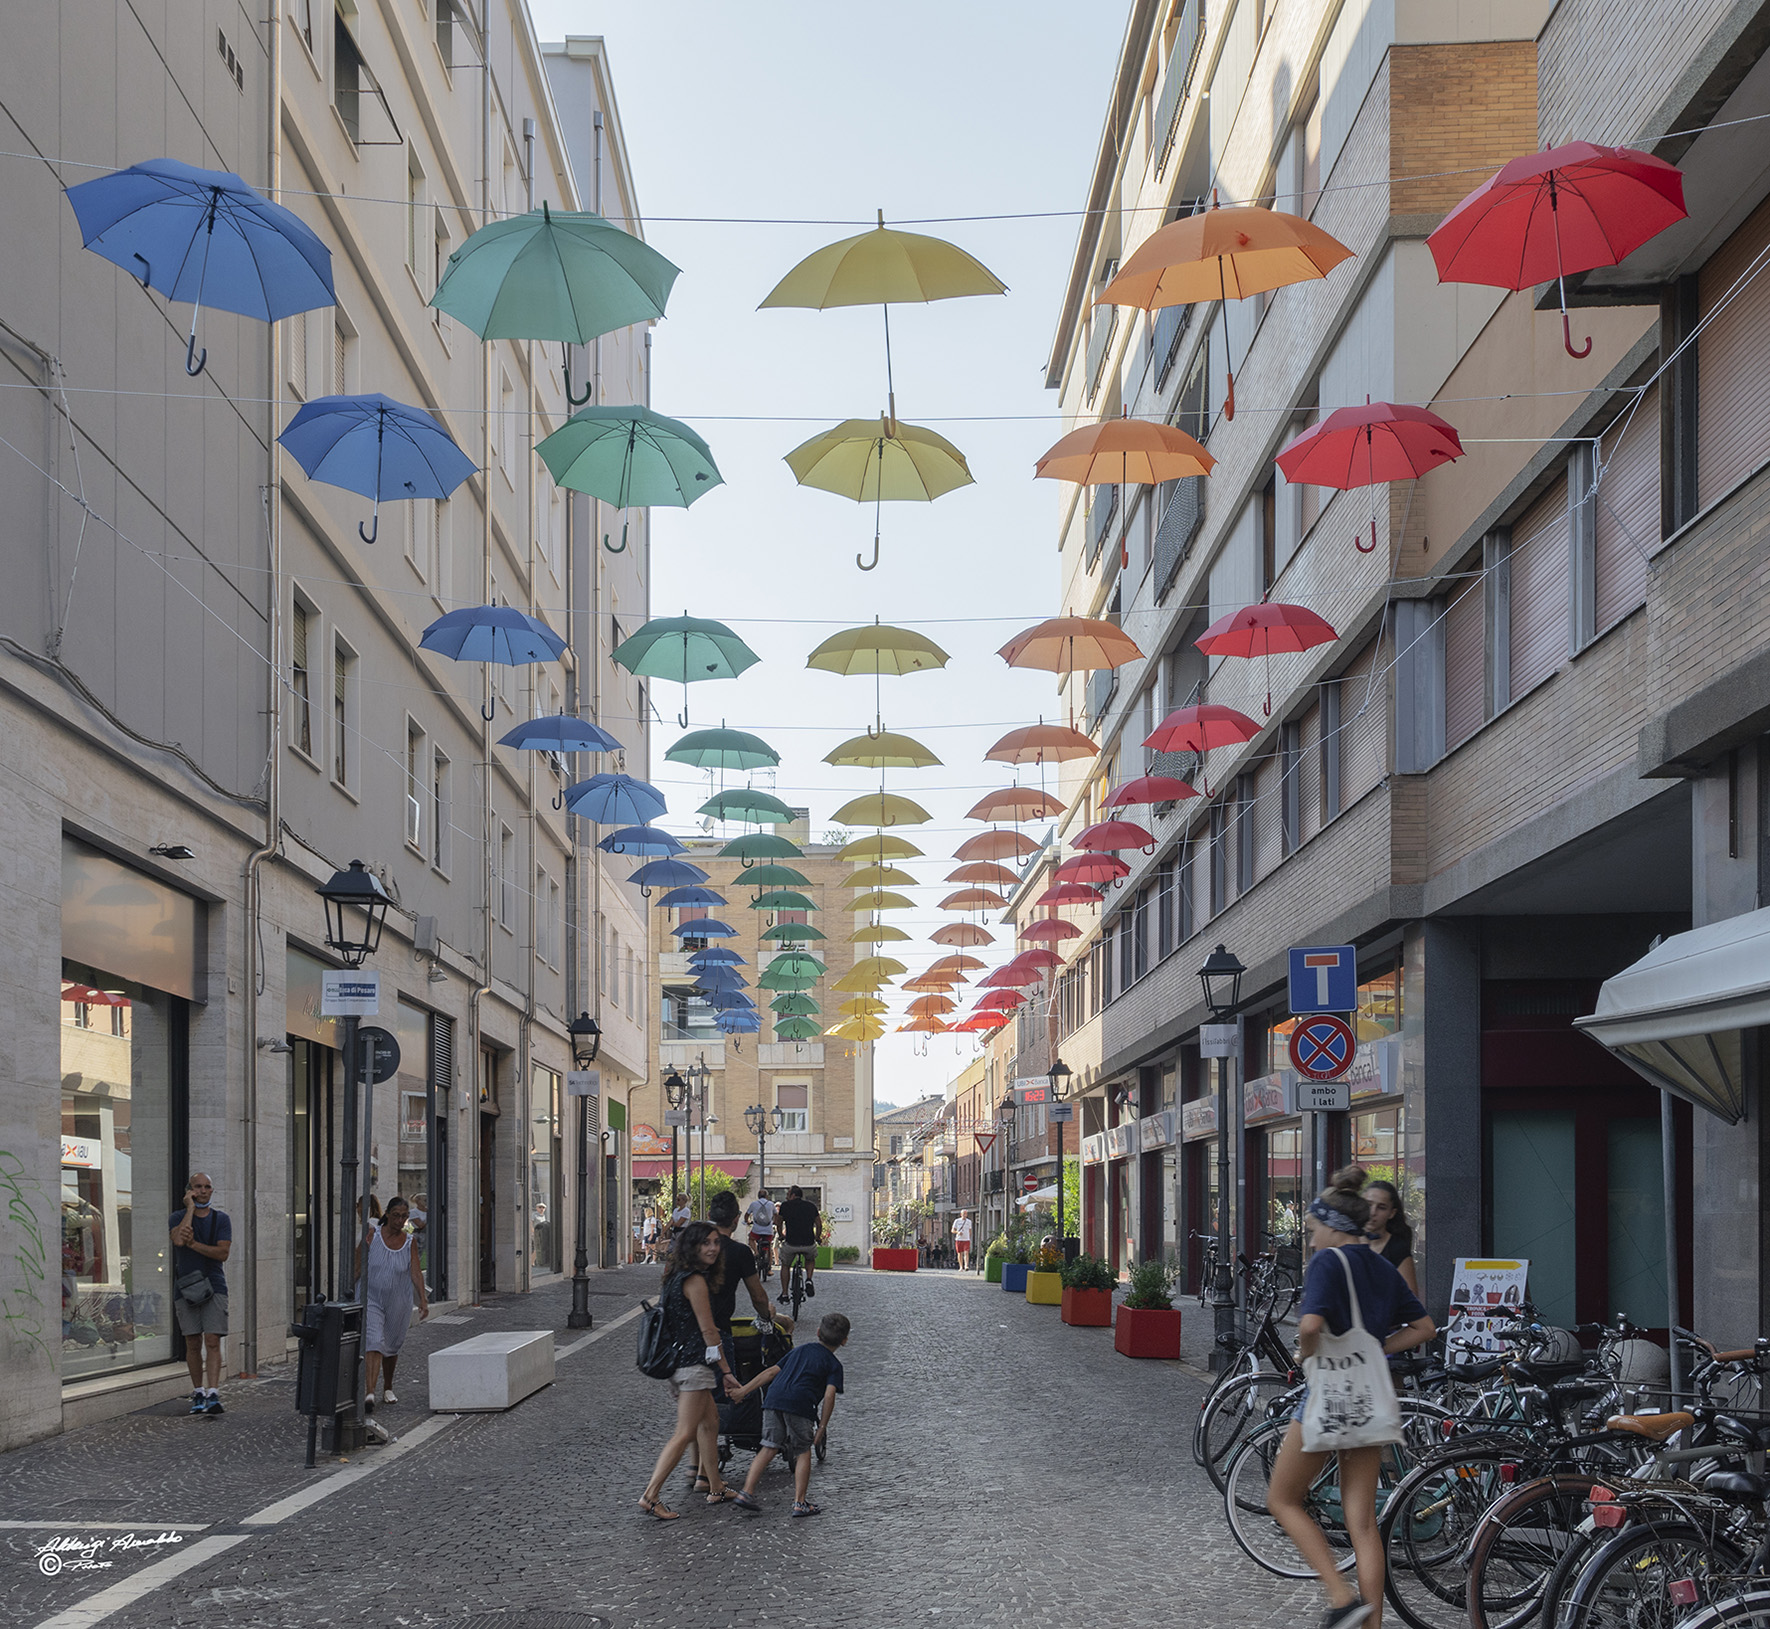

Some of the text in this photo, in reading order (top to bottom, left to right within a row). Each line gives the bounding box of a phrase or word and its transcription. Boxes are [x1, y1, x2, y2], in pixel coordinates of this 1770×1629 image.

[1025, 1090, 1045, 1101] 16:23
[1311, 1087, 1337, 1095] ambo
[1313, 1098, 1335, 1106] i lati
[1317, 1351, 1367, 1371] LYON
